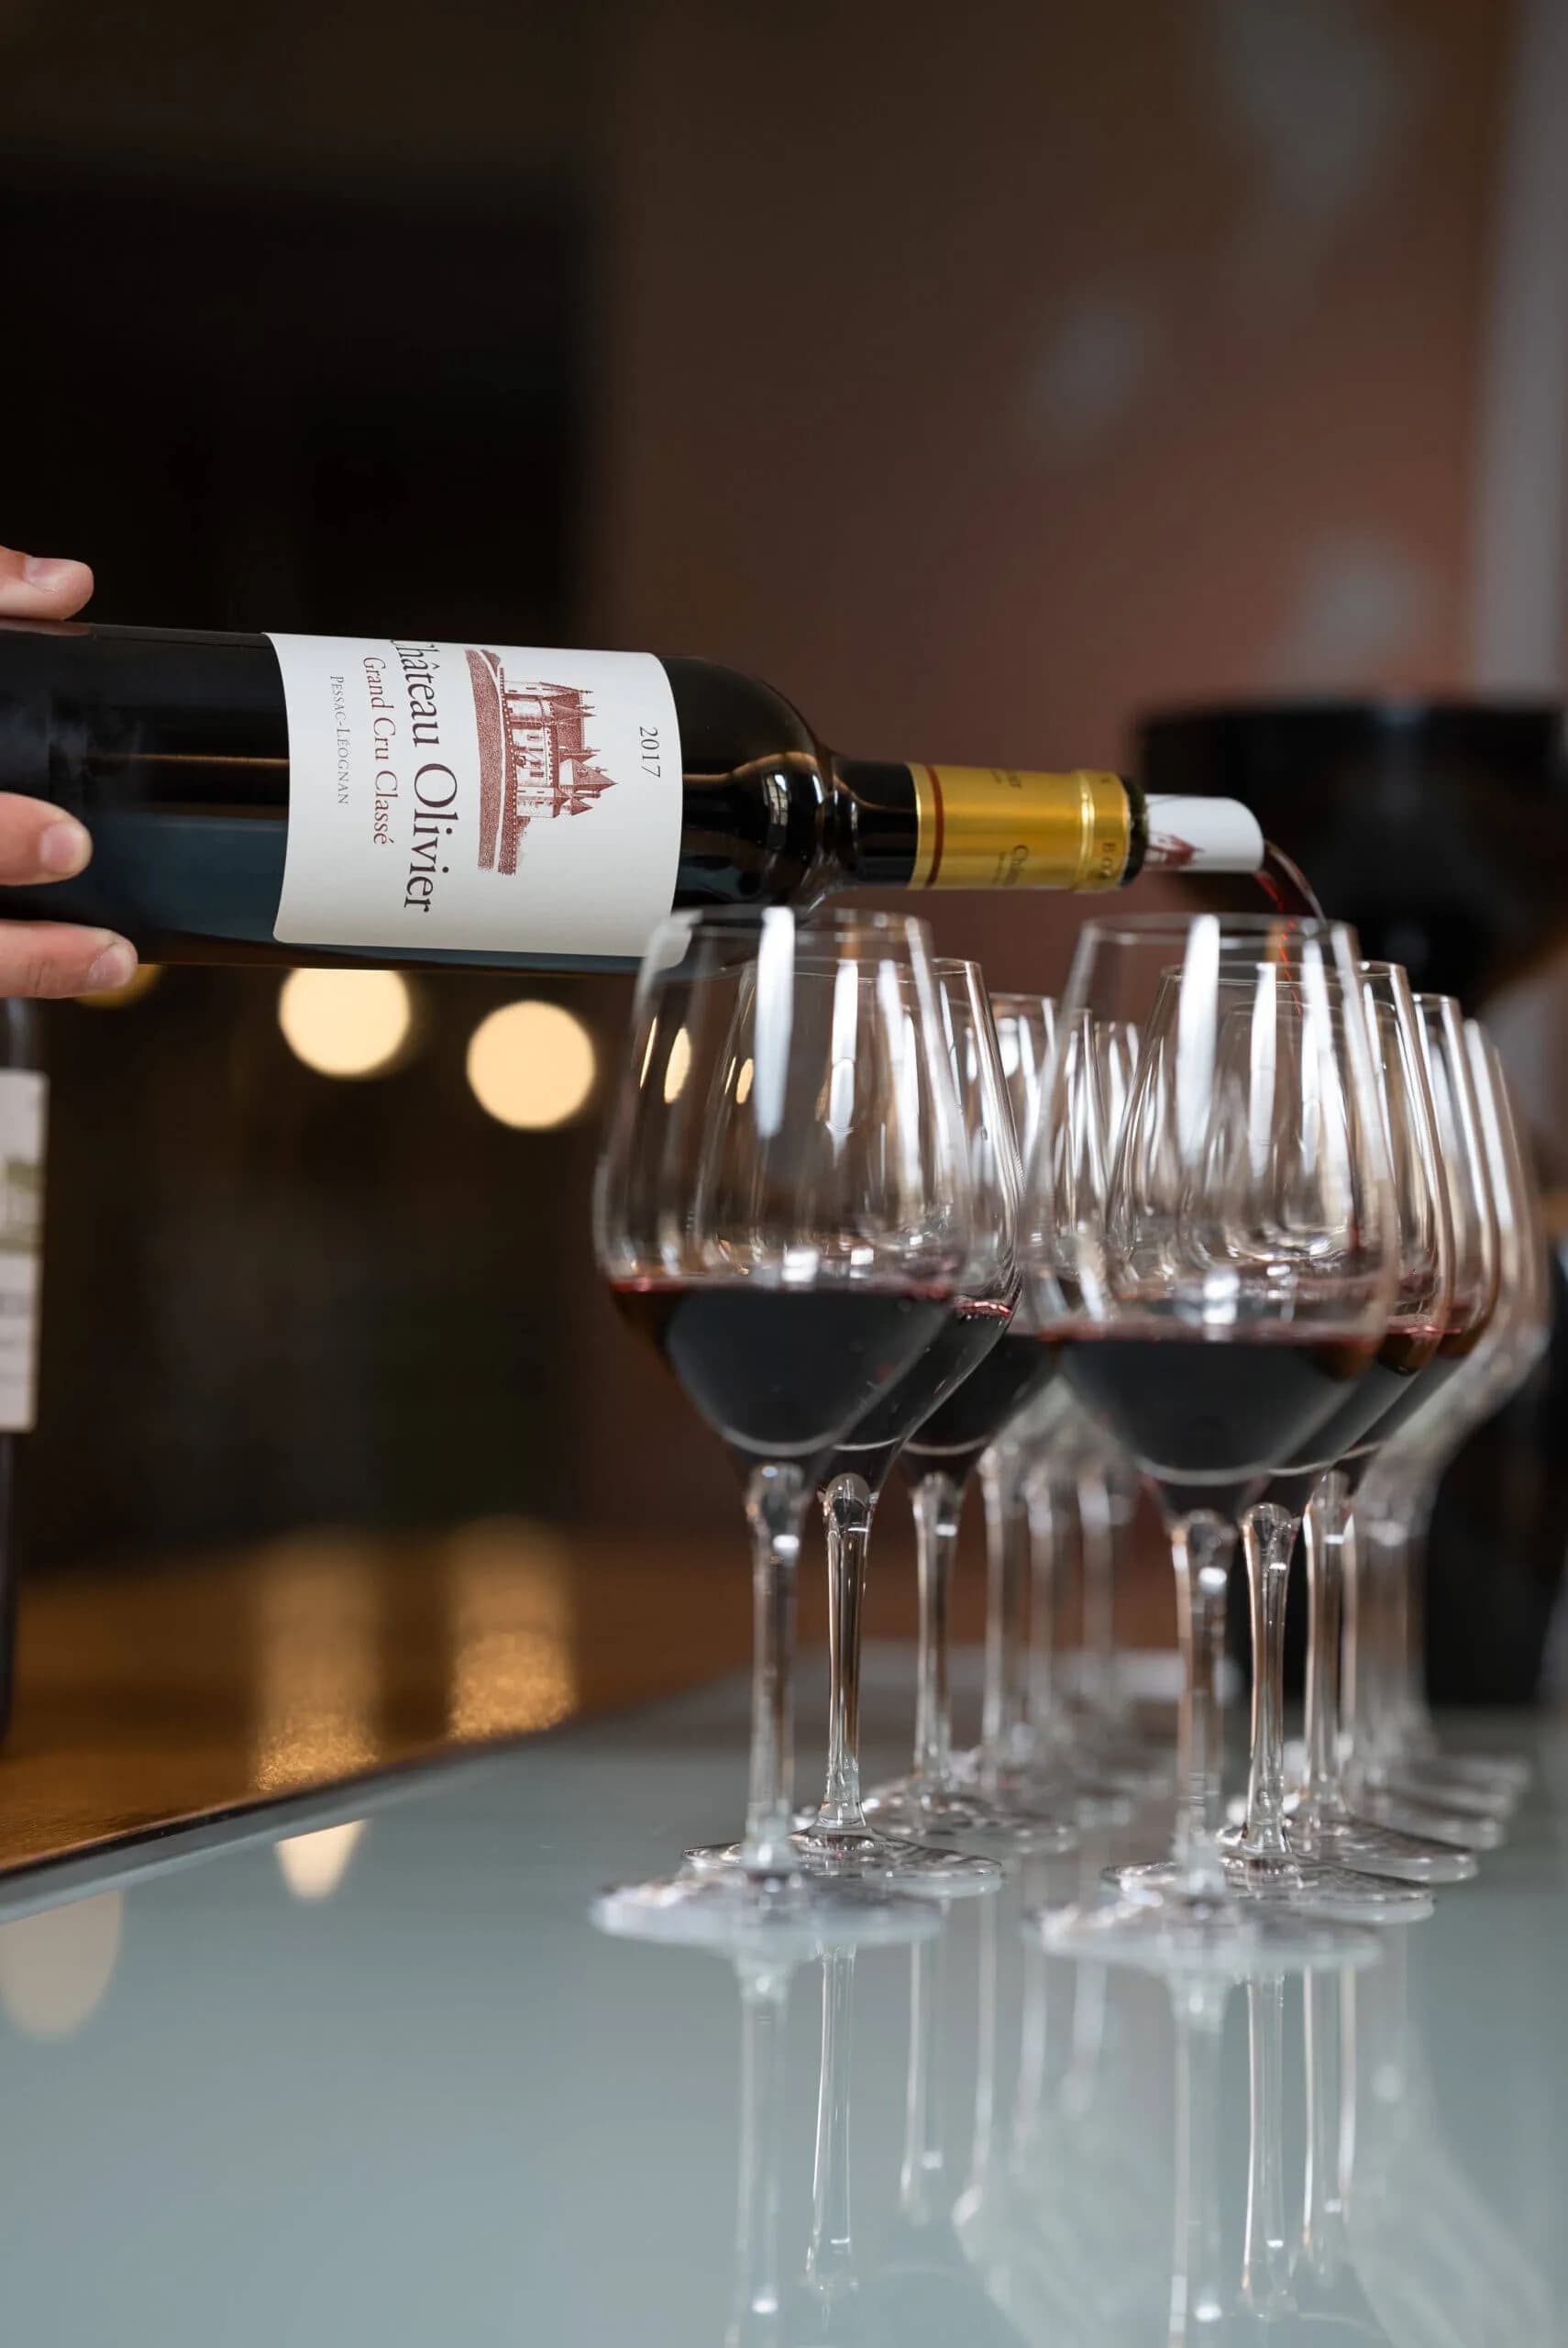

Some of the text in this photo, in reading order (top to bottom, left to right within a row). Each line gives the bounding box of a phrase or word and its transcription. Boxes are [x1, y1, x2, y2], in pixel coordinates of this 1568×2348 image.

[330, 675, 352, 804] PESSAC-LÉOGNAN
[363, 657, 398, 845] Grand Cru Classé
[639, 725, 661, 778] 2017
[404, 763, 458, 913] Olivier
